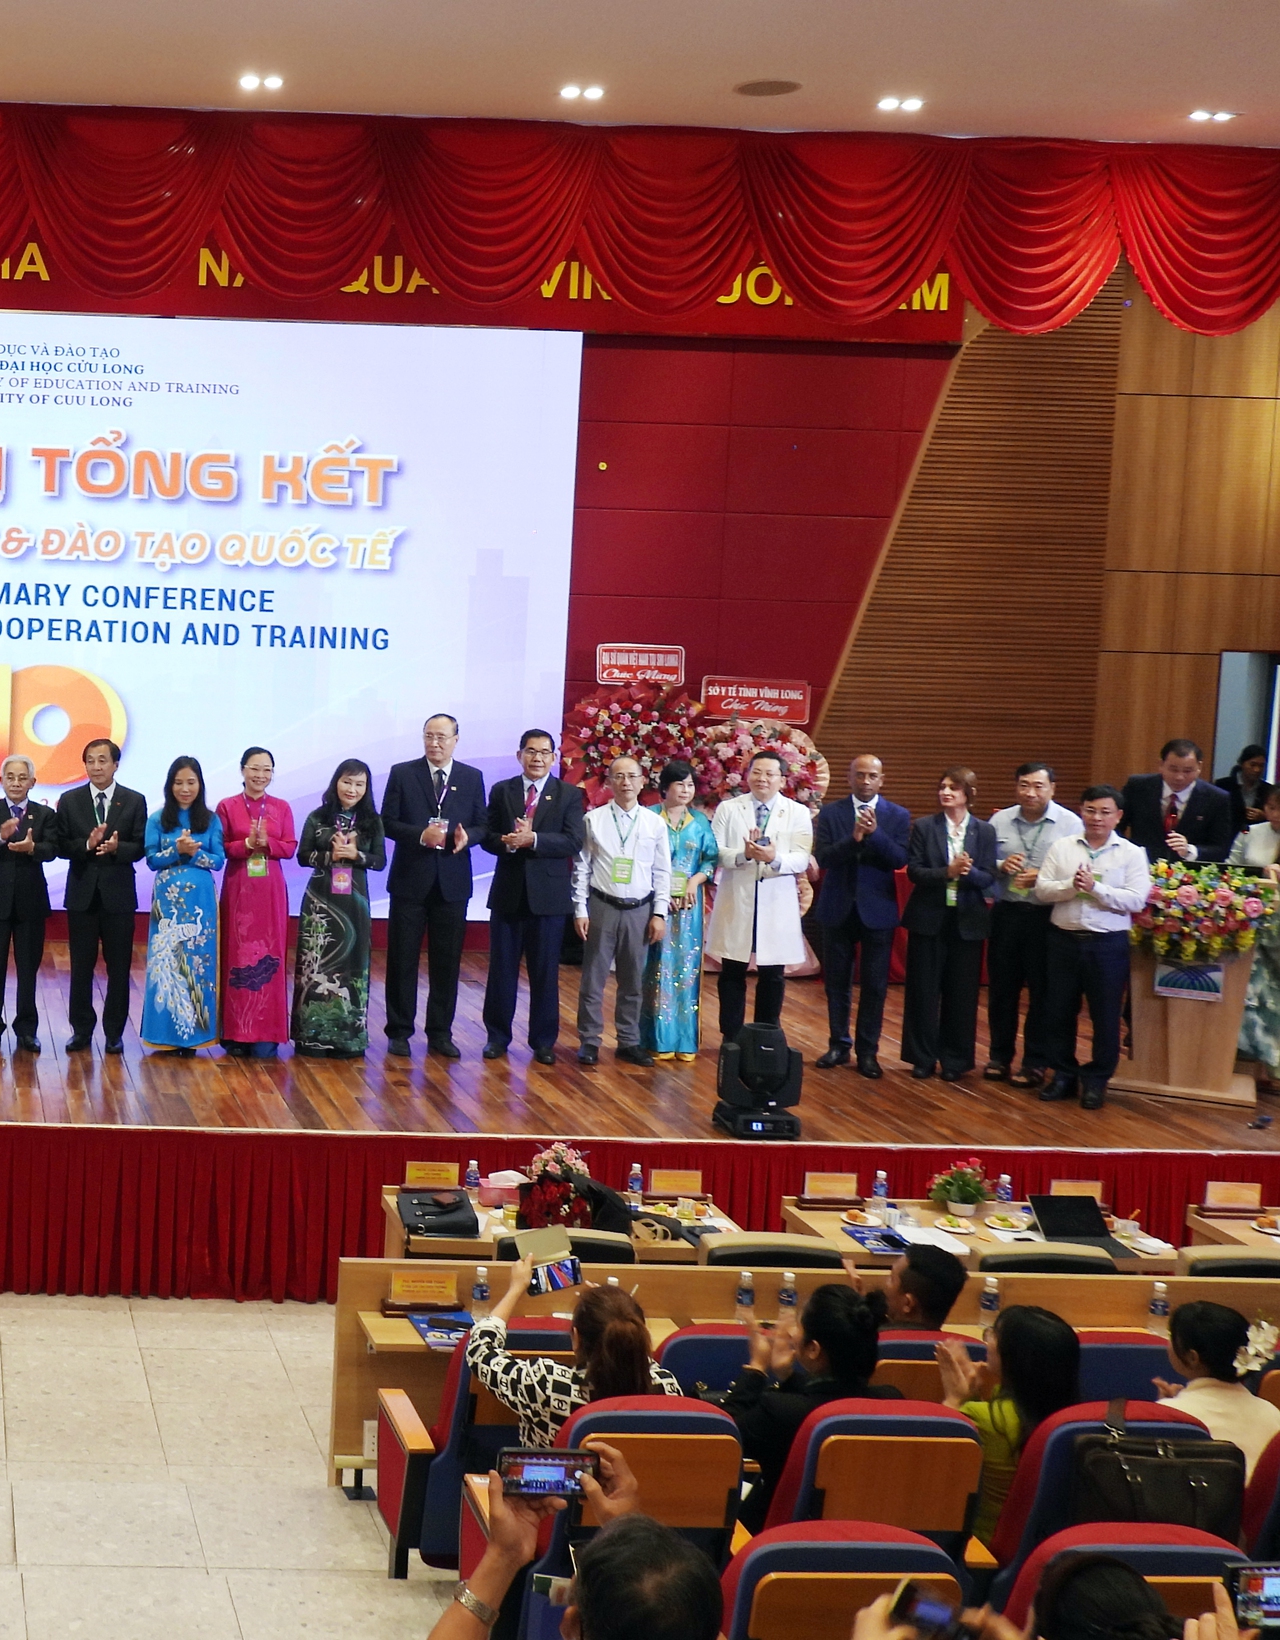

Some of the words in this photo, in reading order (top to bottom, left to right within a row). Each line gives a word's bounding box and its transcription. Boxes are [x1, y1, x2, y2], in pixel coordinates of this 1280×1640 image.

[30, 342, 50, 356] VÀ
[54, 343, 86, 357] ĐÀO
[89, 347, 121, 360] TẠO
[0, 360, 26, 374] ĐẠI
[30, 361, 63, 375] HỌC
[67, 359, 99, 374] CỬU
[102, 363, 145, 375] LONG
[8, 377, 29, 388] OF
[33, 378, 123, 391] EDUCATION
[127, 381, 161, 393] AND
[165, 382, 240, 395] TRAINING
[29, 393, 50, 405] OF
[54, 394, 87, 406] CUU
[90, 396, 134, 408] LONG
[31, 429, 235, 499] TỔNG
[261, 438, 395, 503] KẾT
[0, 526, 31, 556] &
[40, 521, 122, 558] ĐÀO
[134, 531, 208, 568] TẠO
[218, 526, 337, 564] QUỐC
[345, 529, 399, 566] TẾ
[82, 584, 275, 613] CONFERENCE
[181, 622, 240, 647] AND
[251, 624, 390, 651] TRAINING
[780, 689, 804, 700] LONG
